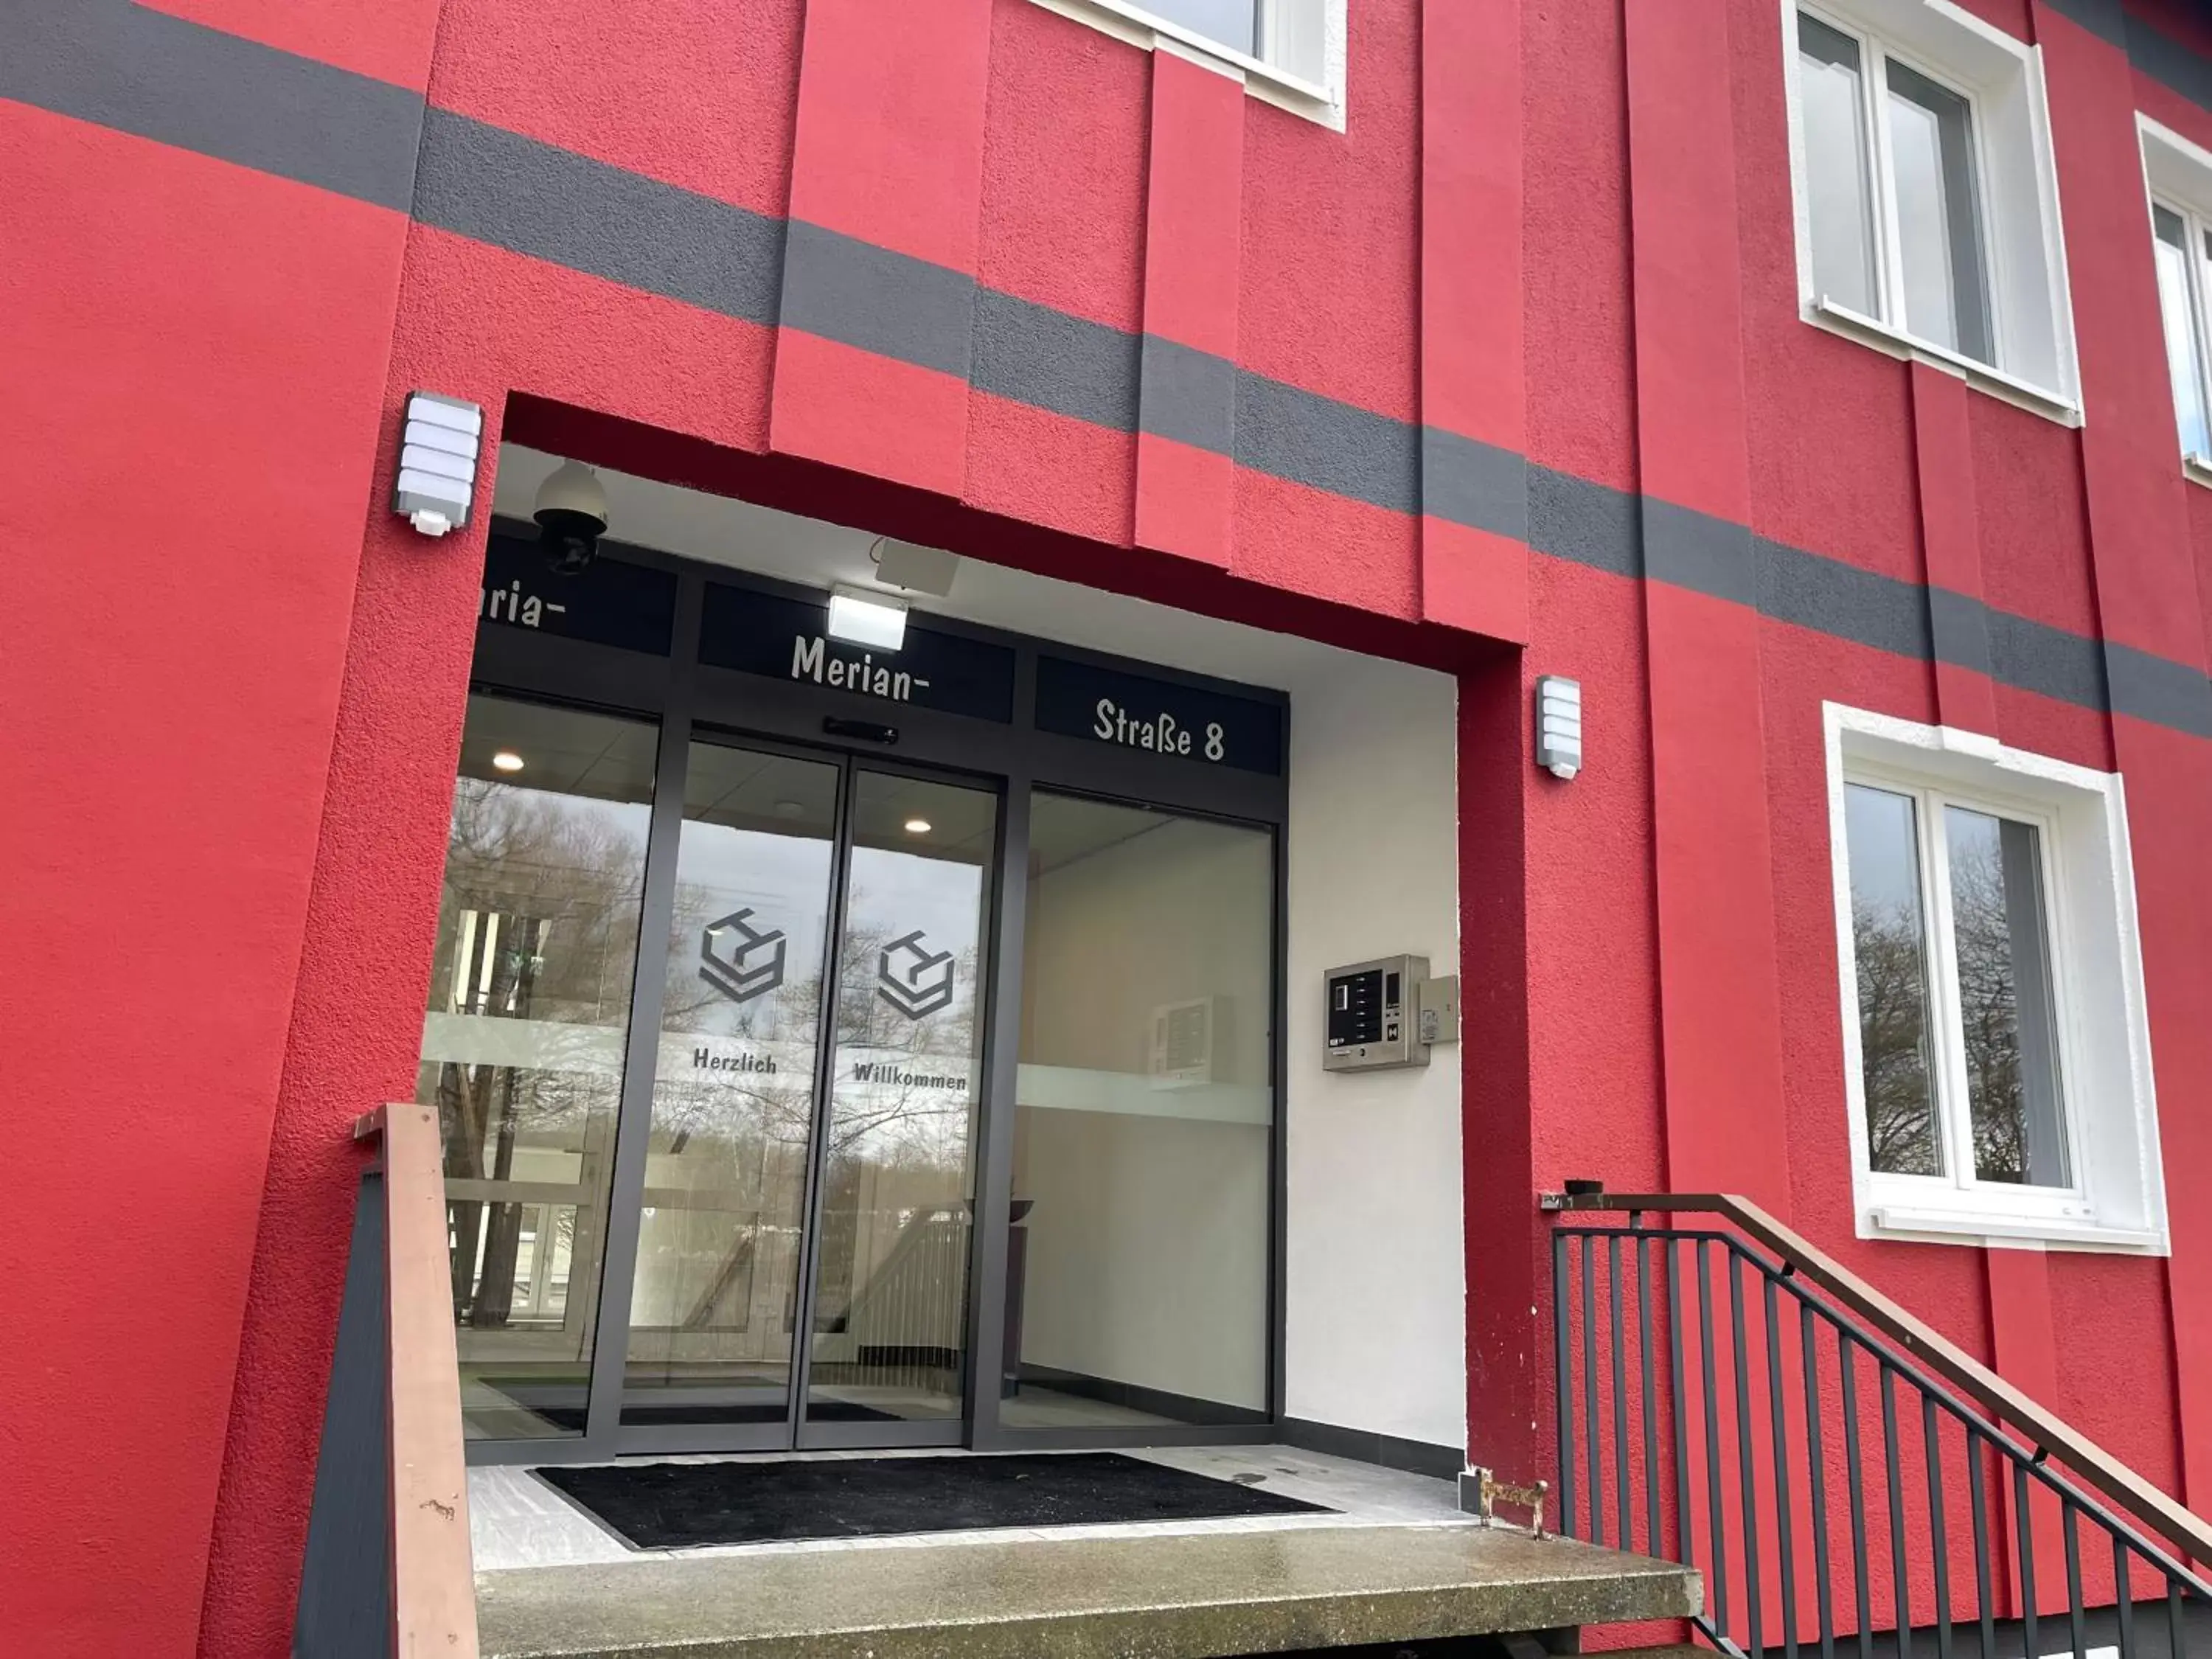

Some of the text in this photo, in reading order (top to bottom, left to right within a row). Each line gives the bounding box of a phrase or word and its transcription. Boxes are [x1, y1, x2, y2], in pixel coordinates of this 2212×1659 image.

[791, 635, 930, 700] Merian-
[1094, 698, 1192, 756] Straße
[1204, 723, 1225, 762] 8
[693, 1048, 967, 1091] Herzlich Willkommen
